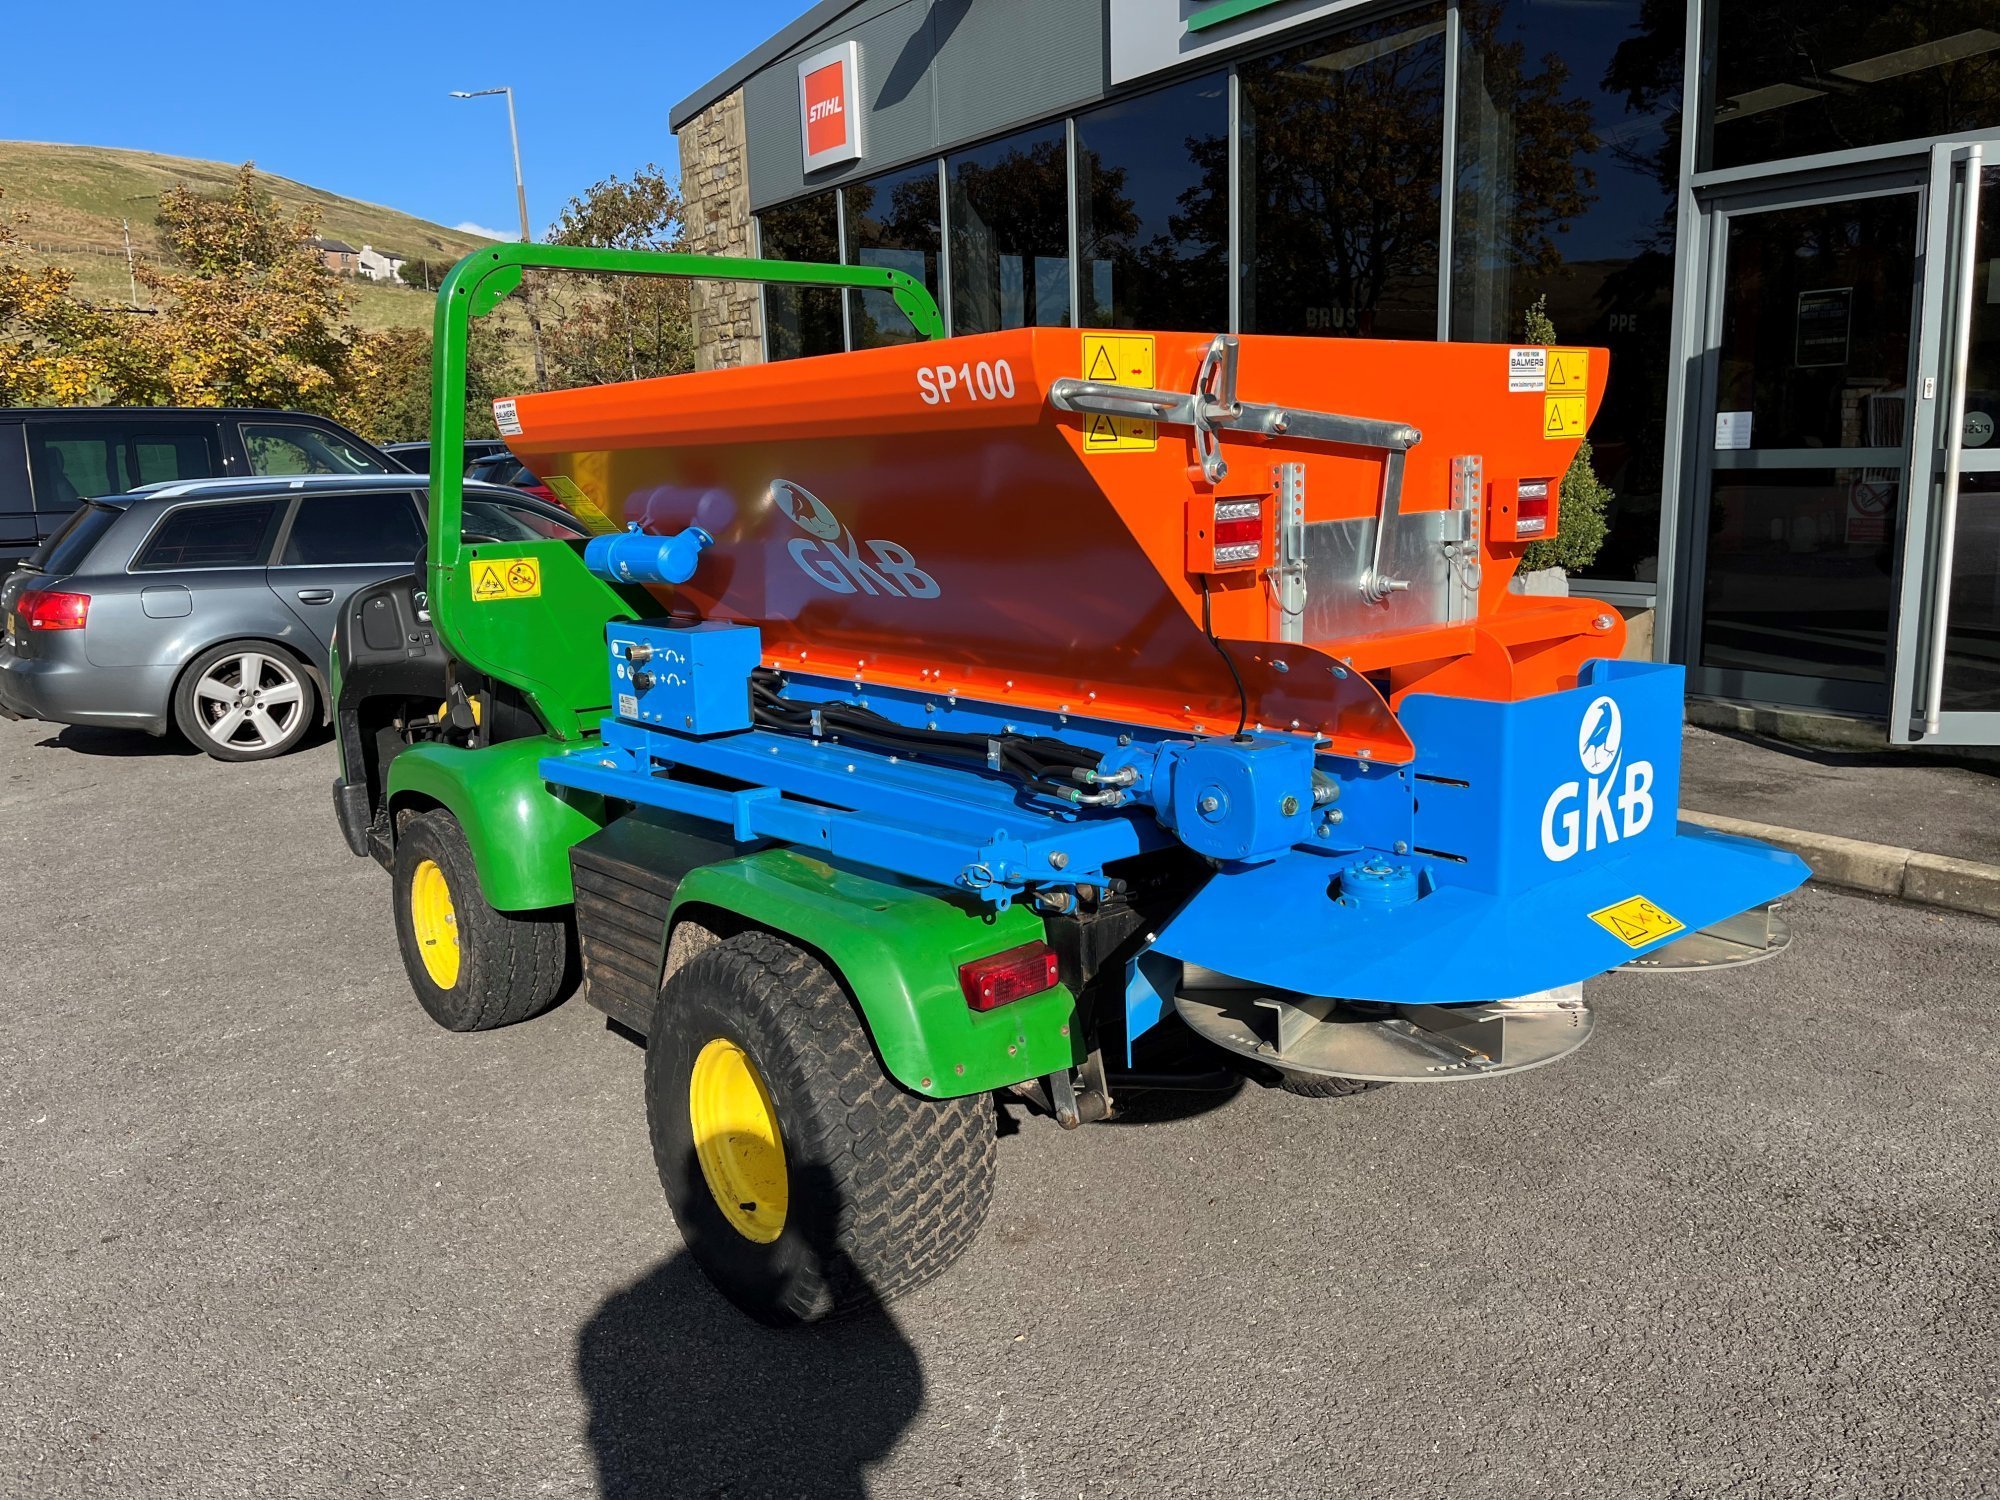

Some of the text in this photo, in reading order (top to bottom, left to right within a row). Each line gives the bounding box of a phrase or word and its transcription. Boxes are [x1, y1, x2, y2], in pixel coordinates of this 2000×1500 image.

[809, 96, 843, 124] STIHL
[1609, 314, 1637, 332] PPE
[1511, 358, 1544, 367] BALMERS
[917, 359, 1015, 405] SP100
[788, 523, 941, 599] GKB
[1541, 747, 1654, 862] GKB
